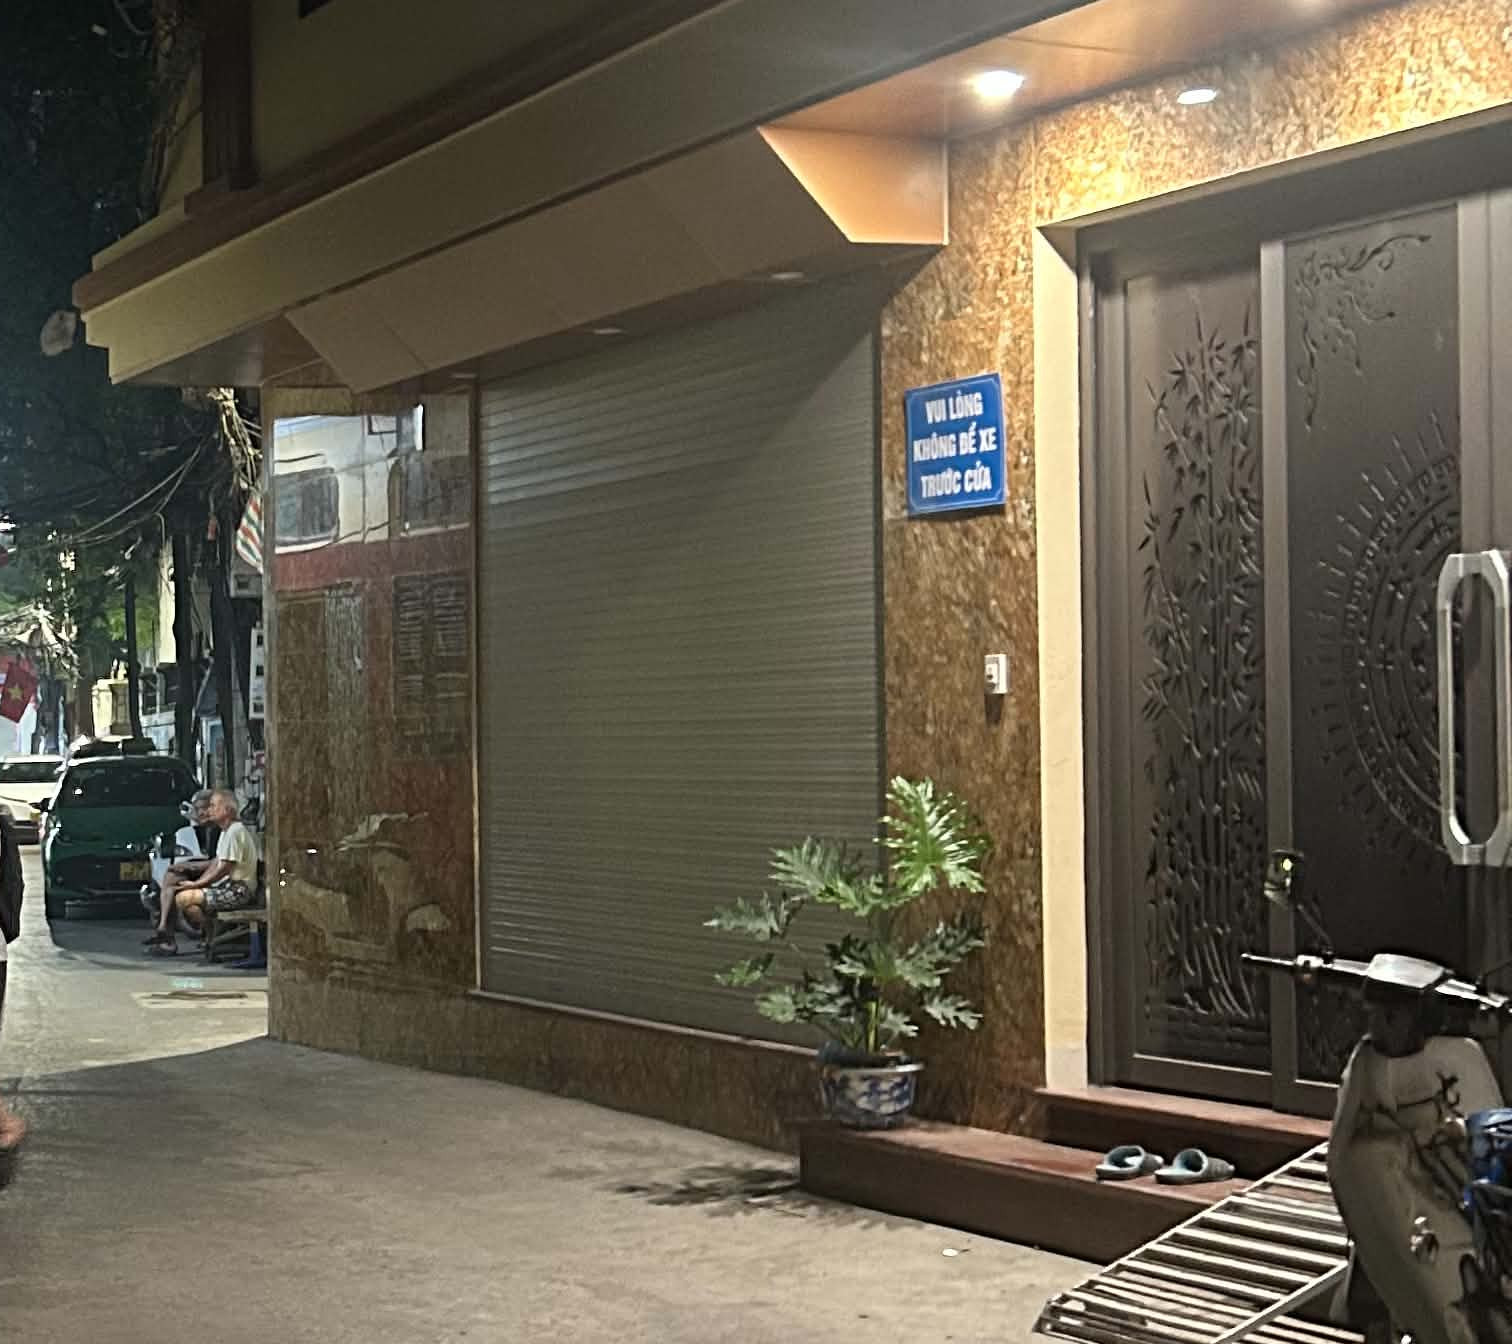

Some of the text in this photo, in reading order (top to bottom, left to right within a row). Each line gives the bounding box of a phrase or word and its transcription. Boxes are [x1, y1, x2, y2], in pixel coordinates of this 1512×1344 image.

[925, 389, 983, 424] VUI LÒNG
[913, 432, 956, 462] KHÔNG
[979, 427, 998, 452] XE
[921, 460, 992, 498] TRƯỚC CỬA
